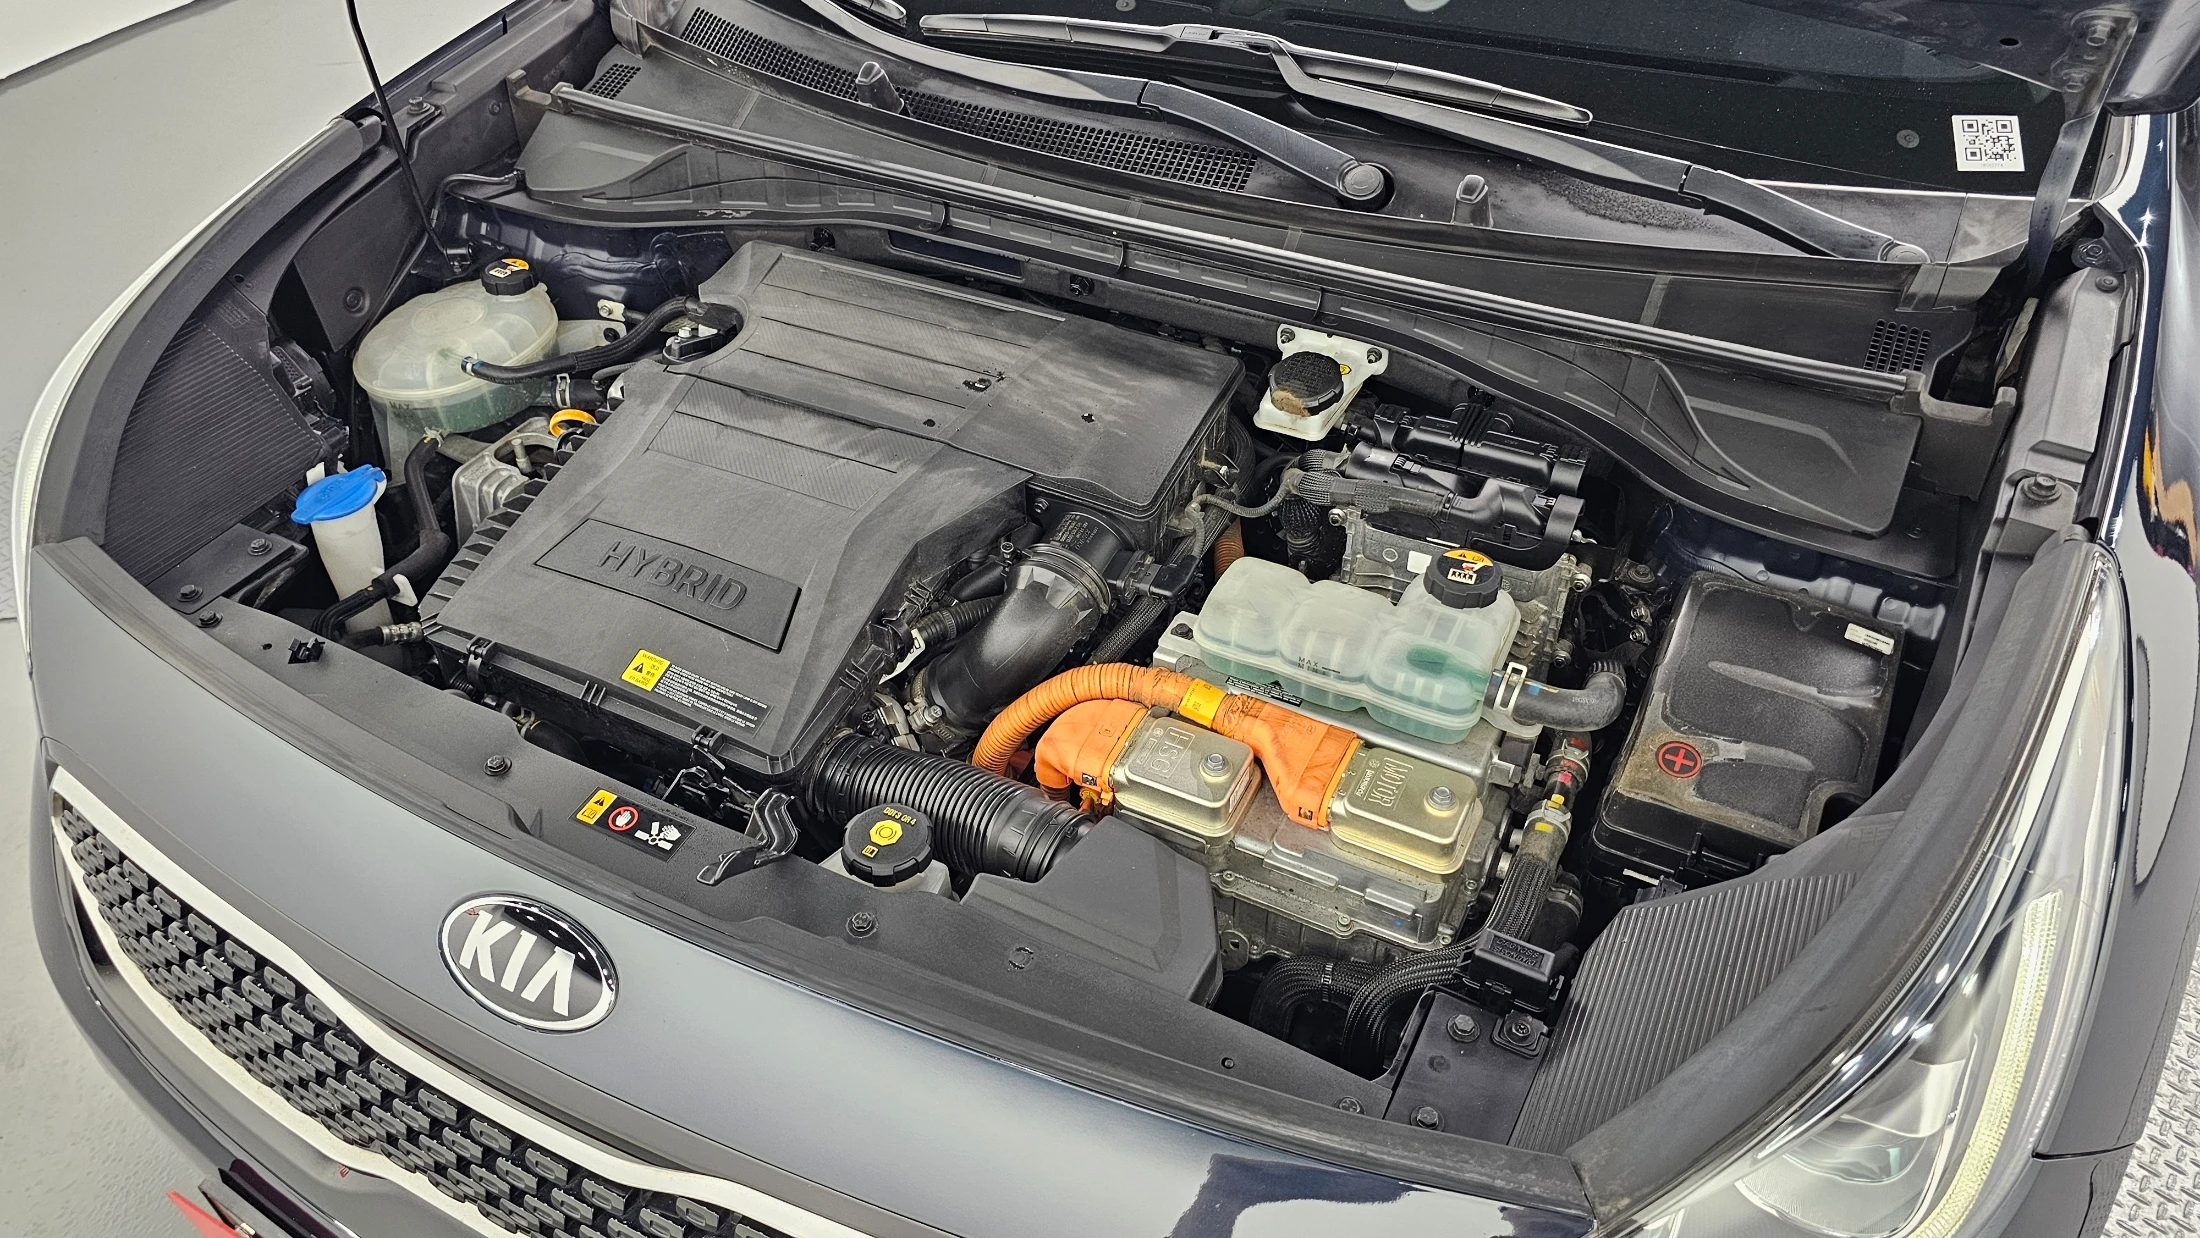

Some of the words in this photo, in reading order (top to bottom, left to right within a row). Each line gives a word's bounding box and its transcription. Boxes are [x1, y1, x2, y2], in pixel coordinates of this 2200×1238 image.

[596, 539, 748, 611] HYBRID
[642, 652, 665, 666] WARNING
[1297, 662, 1319, 674] MIN
[1298, 656, 1319, 668] MAX
[1151, 731, 1190, 773] HSG
[1367, 762, 1409, 807] MOTOR
[901, 814, 912, 824] OR
[910, 818, 917, 826] 4
[1496, 938, 1540, 958] DIAGNOSIS
[458, 909, 576, 1017] KIA
